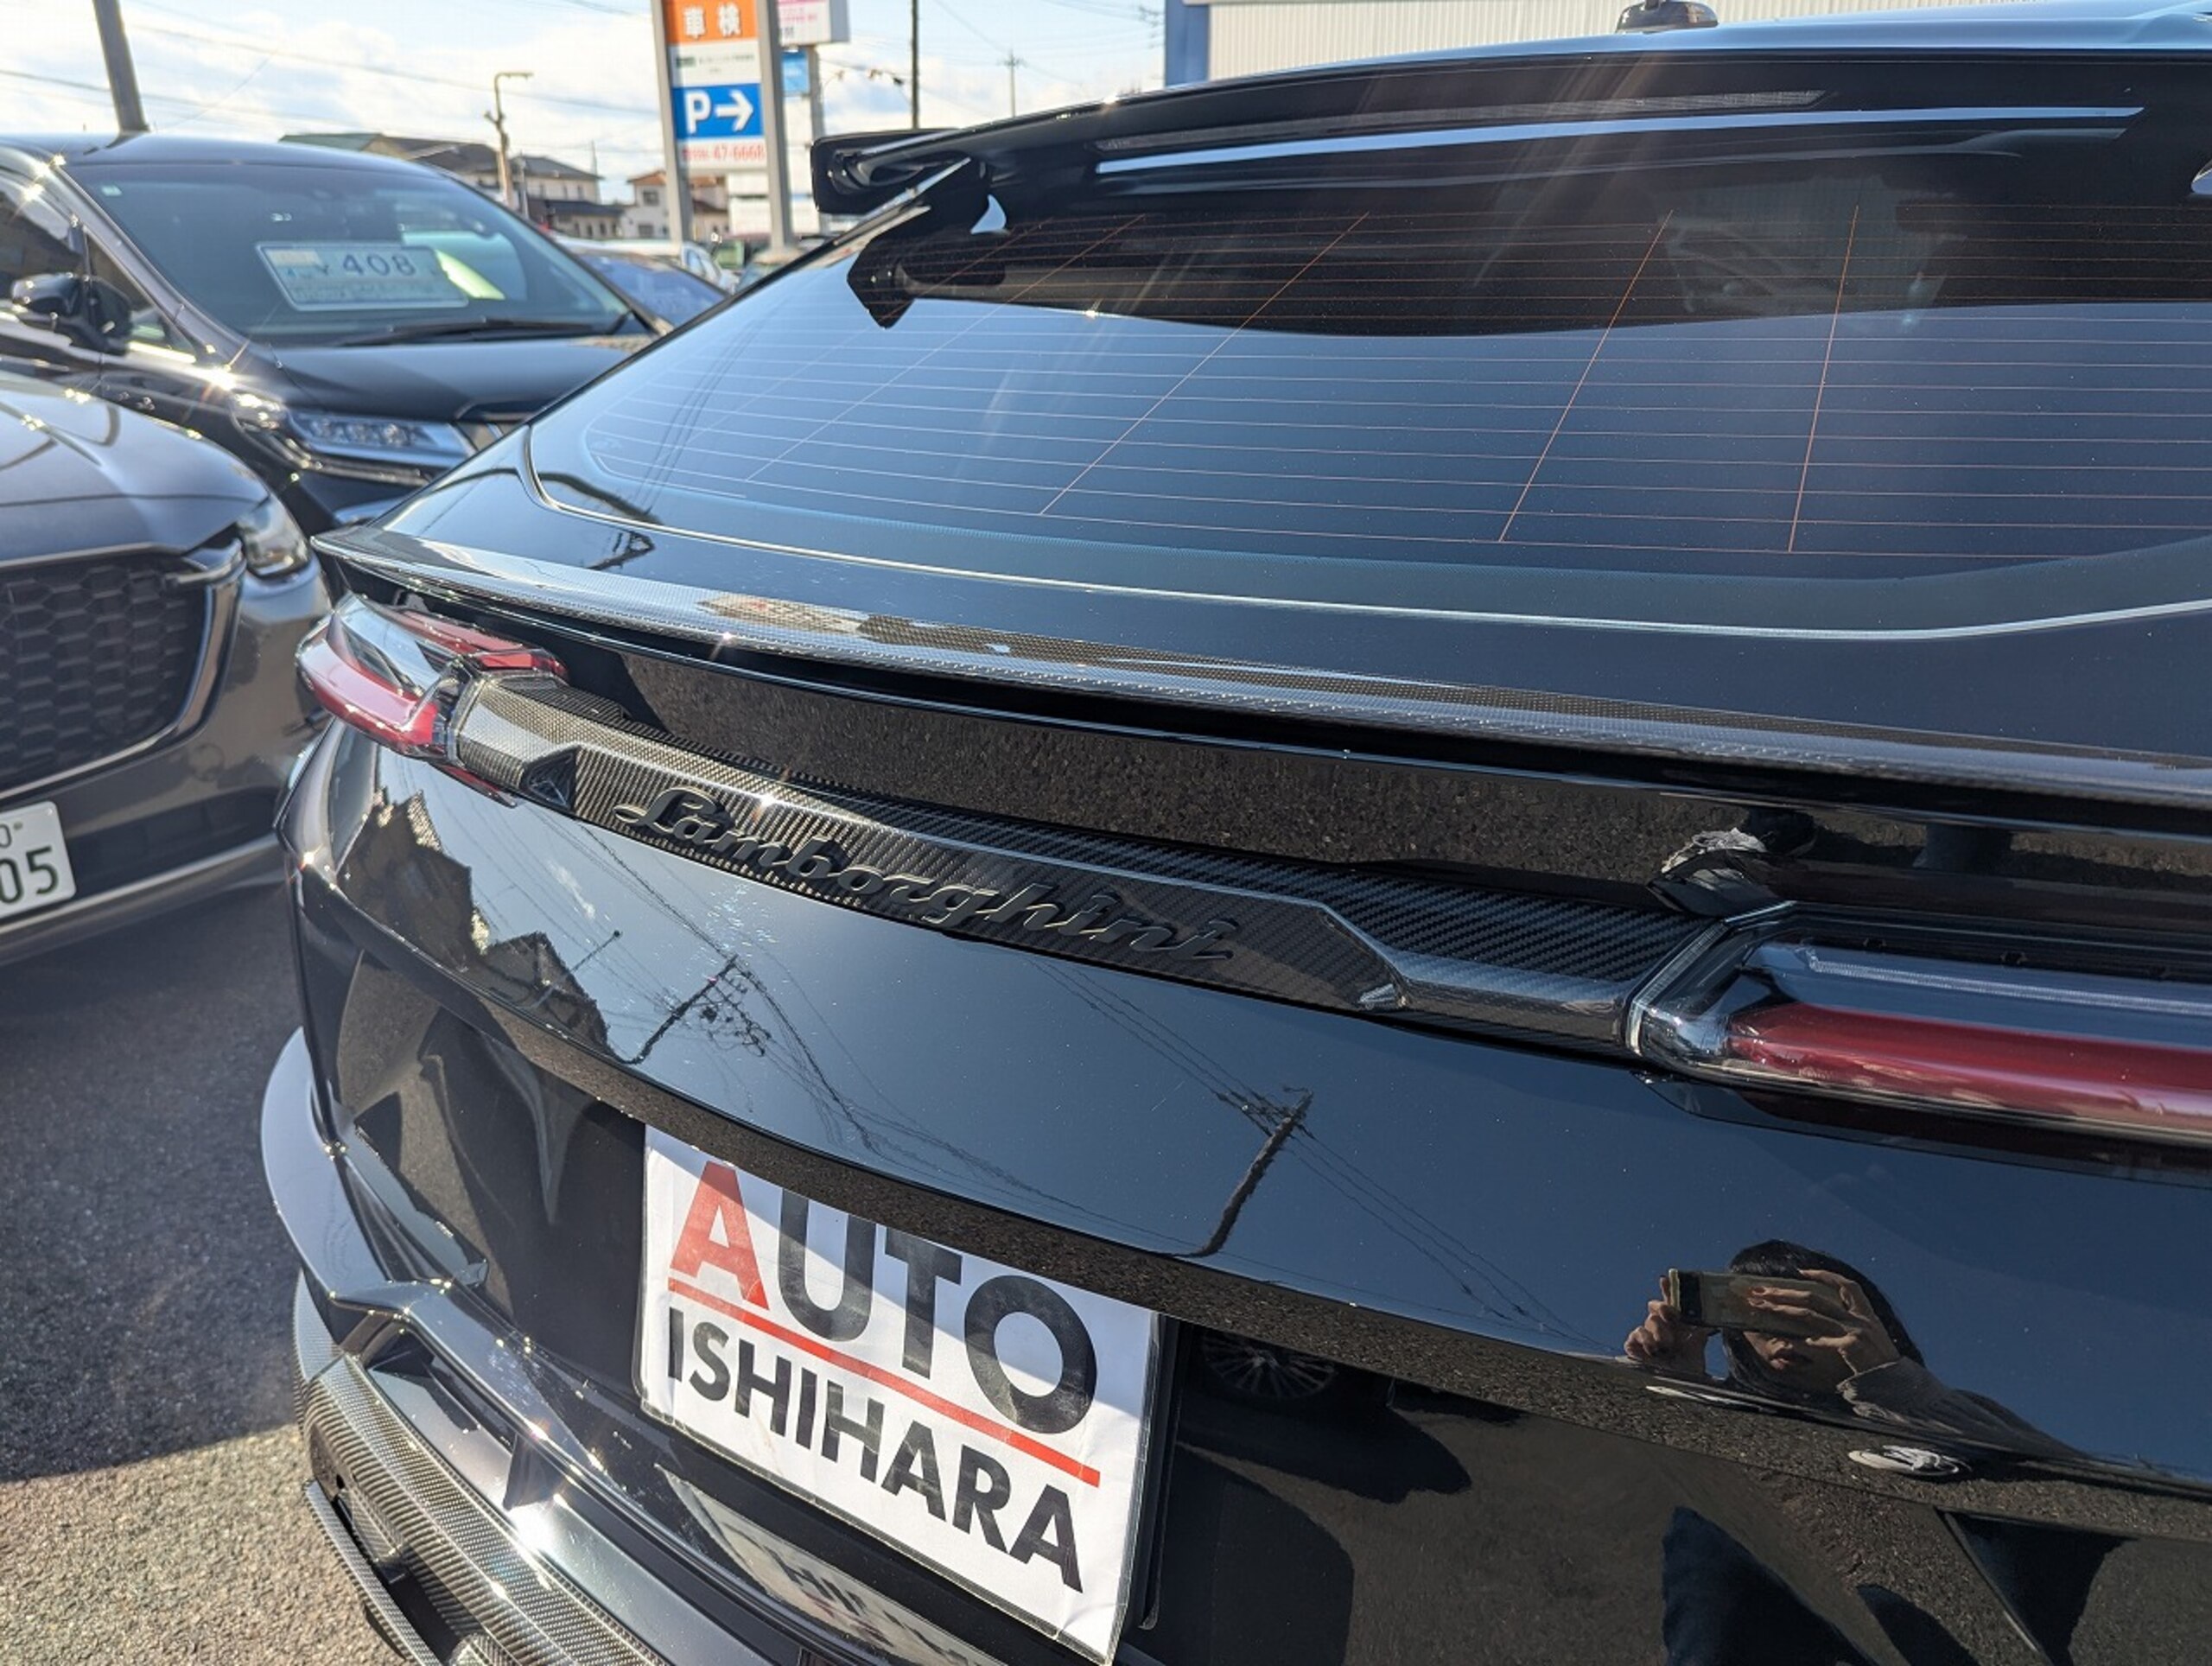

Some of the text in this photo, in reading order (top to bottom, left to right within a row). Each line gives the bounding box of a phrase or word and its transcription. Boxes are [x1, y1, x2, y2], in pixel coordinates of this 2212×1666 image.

[685, 90, 711, 134] P
[342, 253, 416, 277] 408
[613, 786, 1236, 962] Lamborghini
[670, 1160, 1097, 1434] AUTO
[668, 1307, 1084, 1594] ISHIHARA
